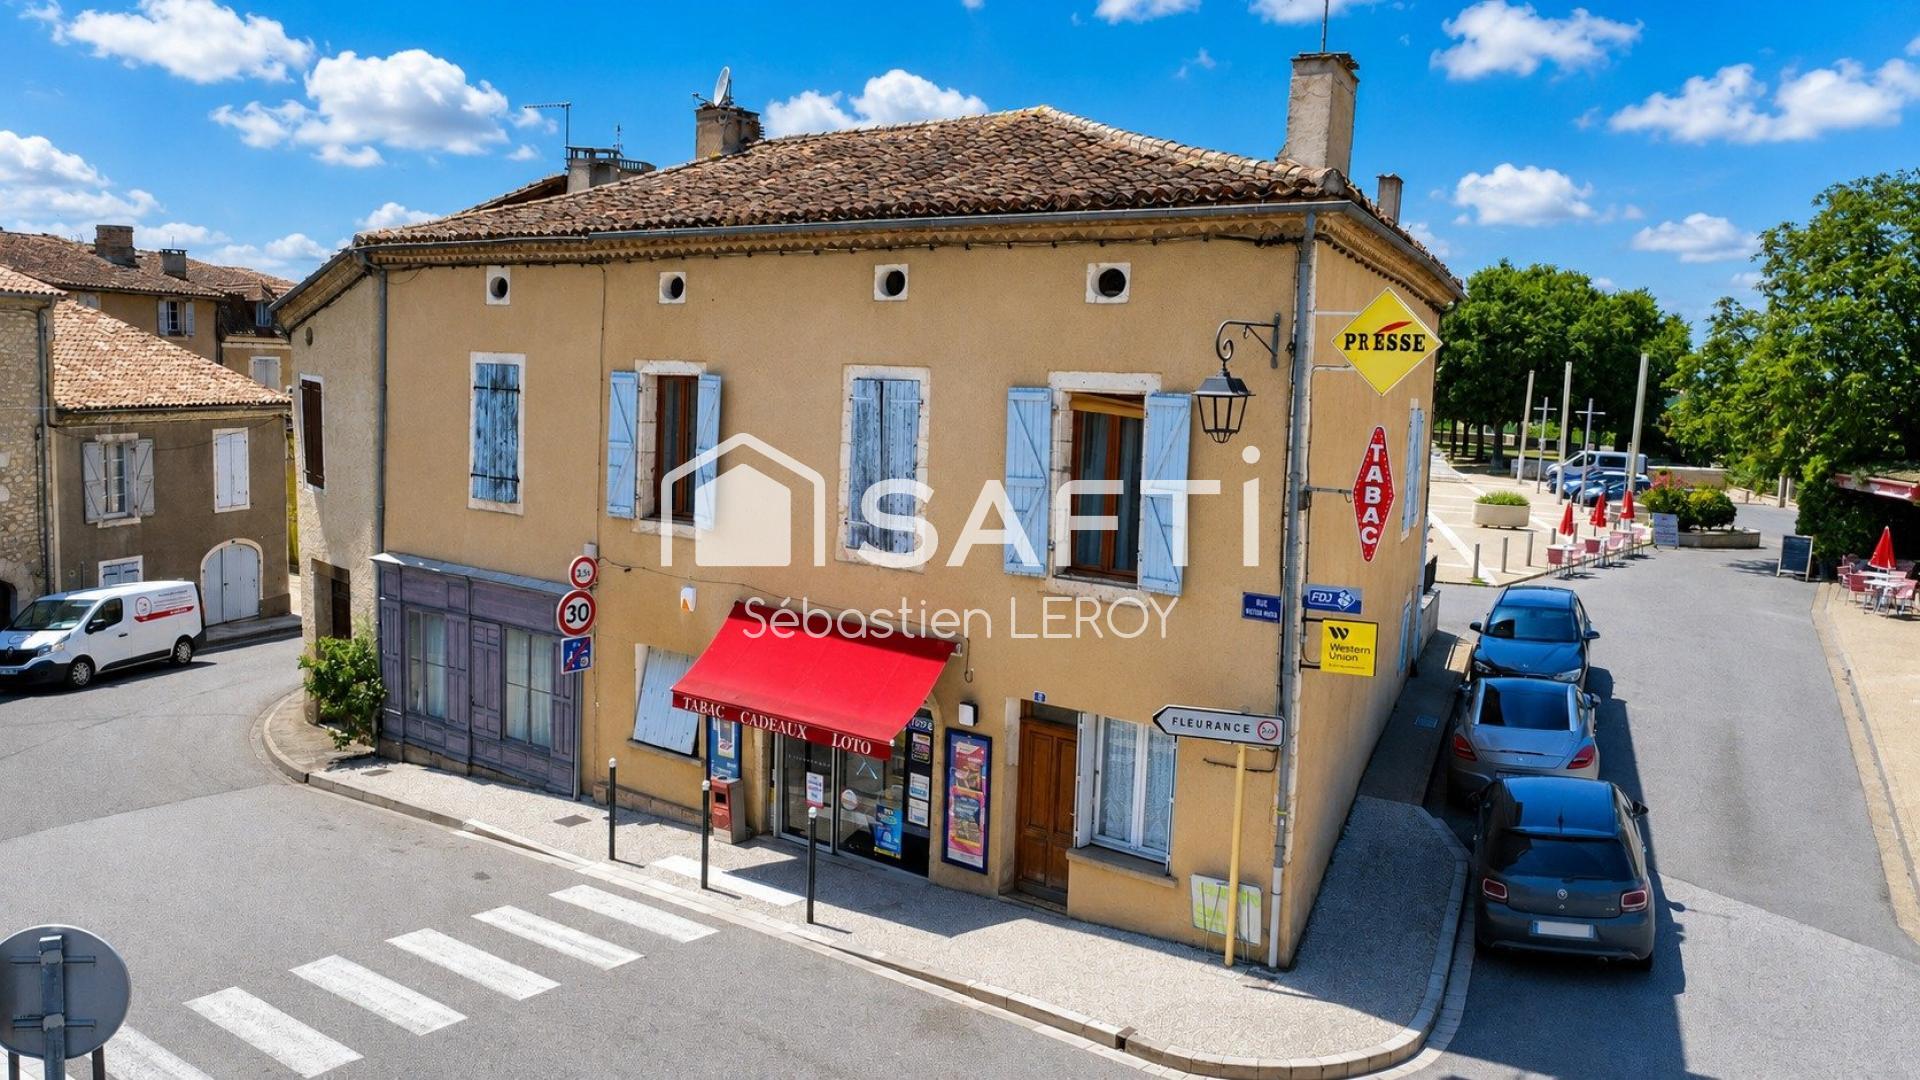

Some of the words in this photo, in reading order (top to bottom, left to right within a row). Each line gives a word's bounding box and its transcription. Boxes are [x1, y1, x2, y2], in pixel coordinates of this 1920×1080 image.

[1343, 331, 1426, 353] PRESSE
[1360, 443, 1385, 546] TABAC
[1311, 592, 1333, 603] FDJ
[565, 602, 590, 624] 30
[1329, 652, 1358, 662] Union
[1330, 643, 1371, 655] Western
[683, 696, 725, 719] TABAC
[740, 711, 808, 741] CADEAUX
[832, 732, 872, 756] LOTO
[1171, 716, 1251, 734] FLEURANCE
